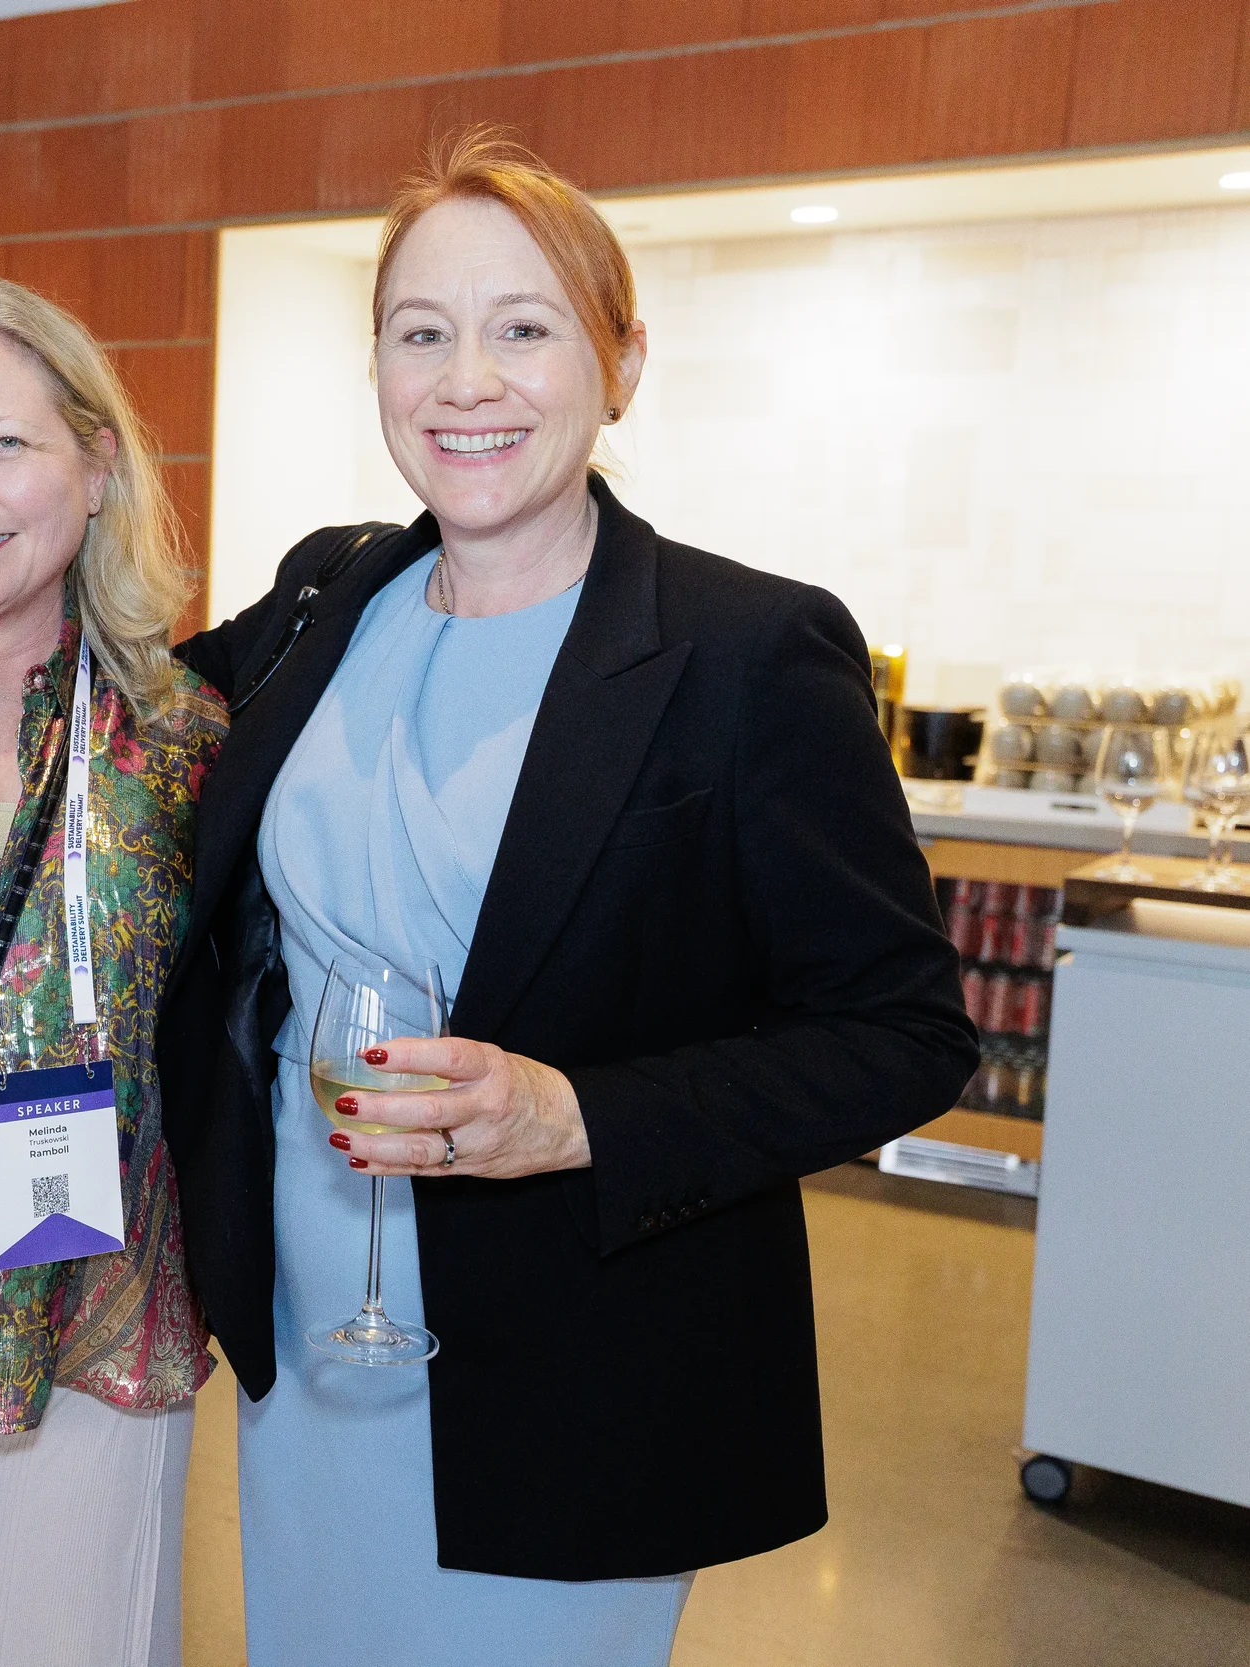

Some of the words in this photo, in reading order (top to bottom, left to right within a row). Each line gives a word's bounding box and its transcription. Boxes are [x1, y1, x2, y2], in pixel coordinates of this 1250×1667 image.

[73, 705, 82, 752] SUSTAINABILITY
[68, 799, 76, 849] SUSTAINABILITY
[76, 895, 84, 925] SUMMIT
[69, 904, 80, 962] SUSTAINABILITY
[78, 925, 88, 962] DELIVERY
[18, 1100, 80, 1116] SPEAKER
[29, 1125, 68, 1137] Melinda
[29, 1134, 70, 1146] Truskowski
[30, 1145, 70, 1158] Ramboll
